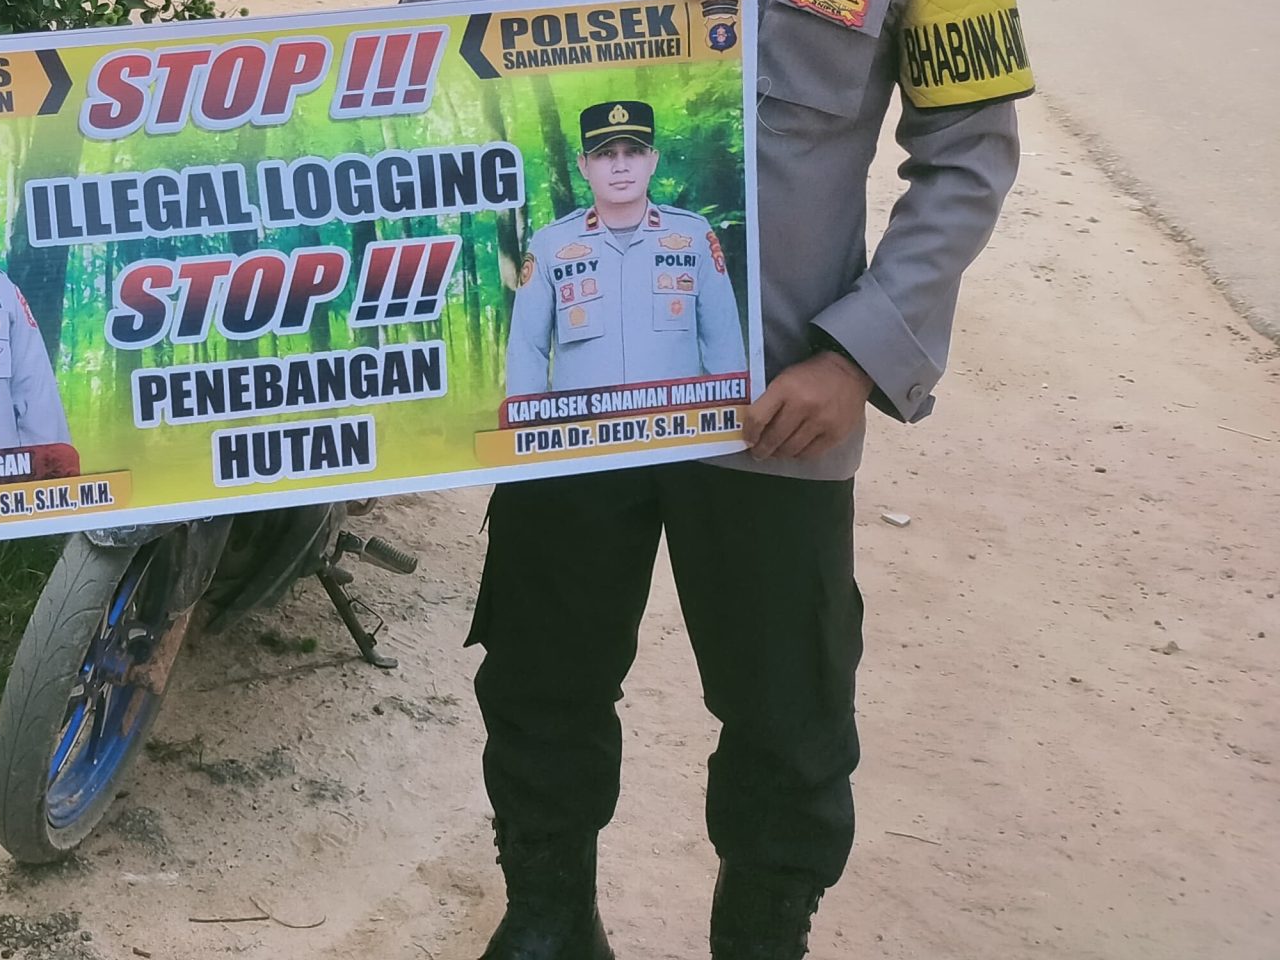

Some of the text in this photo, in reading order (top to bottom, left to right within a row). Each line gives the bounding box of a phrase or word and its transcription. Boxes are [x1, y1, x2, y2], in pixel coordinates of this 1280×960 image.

[500, 4, 681, 50] POLSEK
[503, 37, 681, 70] SANAMAN MANTIKEI
[88, 30, 445, 130] STOP !!!
[31, 148, 519, 240] ILLEGAL LOGGING
[553, 260, 599, 281] DEDY
[655, 254, 696, 268] POLRI
[111, 241, 456, 343] STOP !!!
[138, 347, 442, 422] PENEBANGAN
[507, 378, 746, 423] KAPOLSEK SANAMAN MANTIKEI
[218, 421, 371, 480] HUTAN
[516, 410, 741, 453] IPDA Dr. DEDY, S.H., M.H.
[0, 493, 33, 515] S.H.,
[35, 488, 77, 511] S.I.K.,
[79, 482, 113, 506] M.H.
